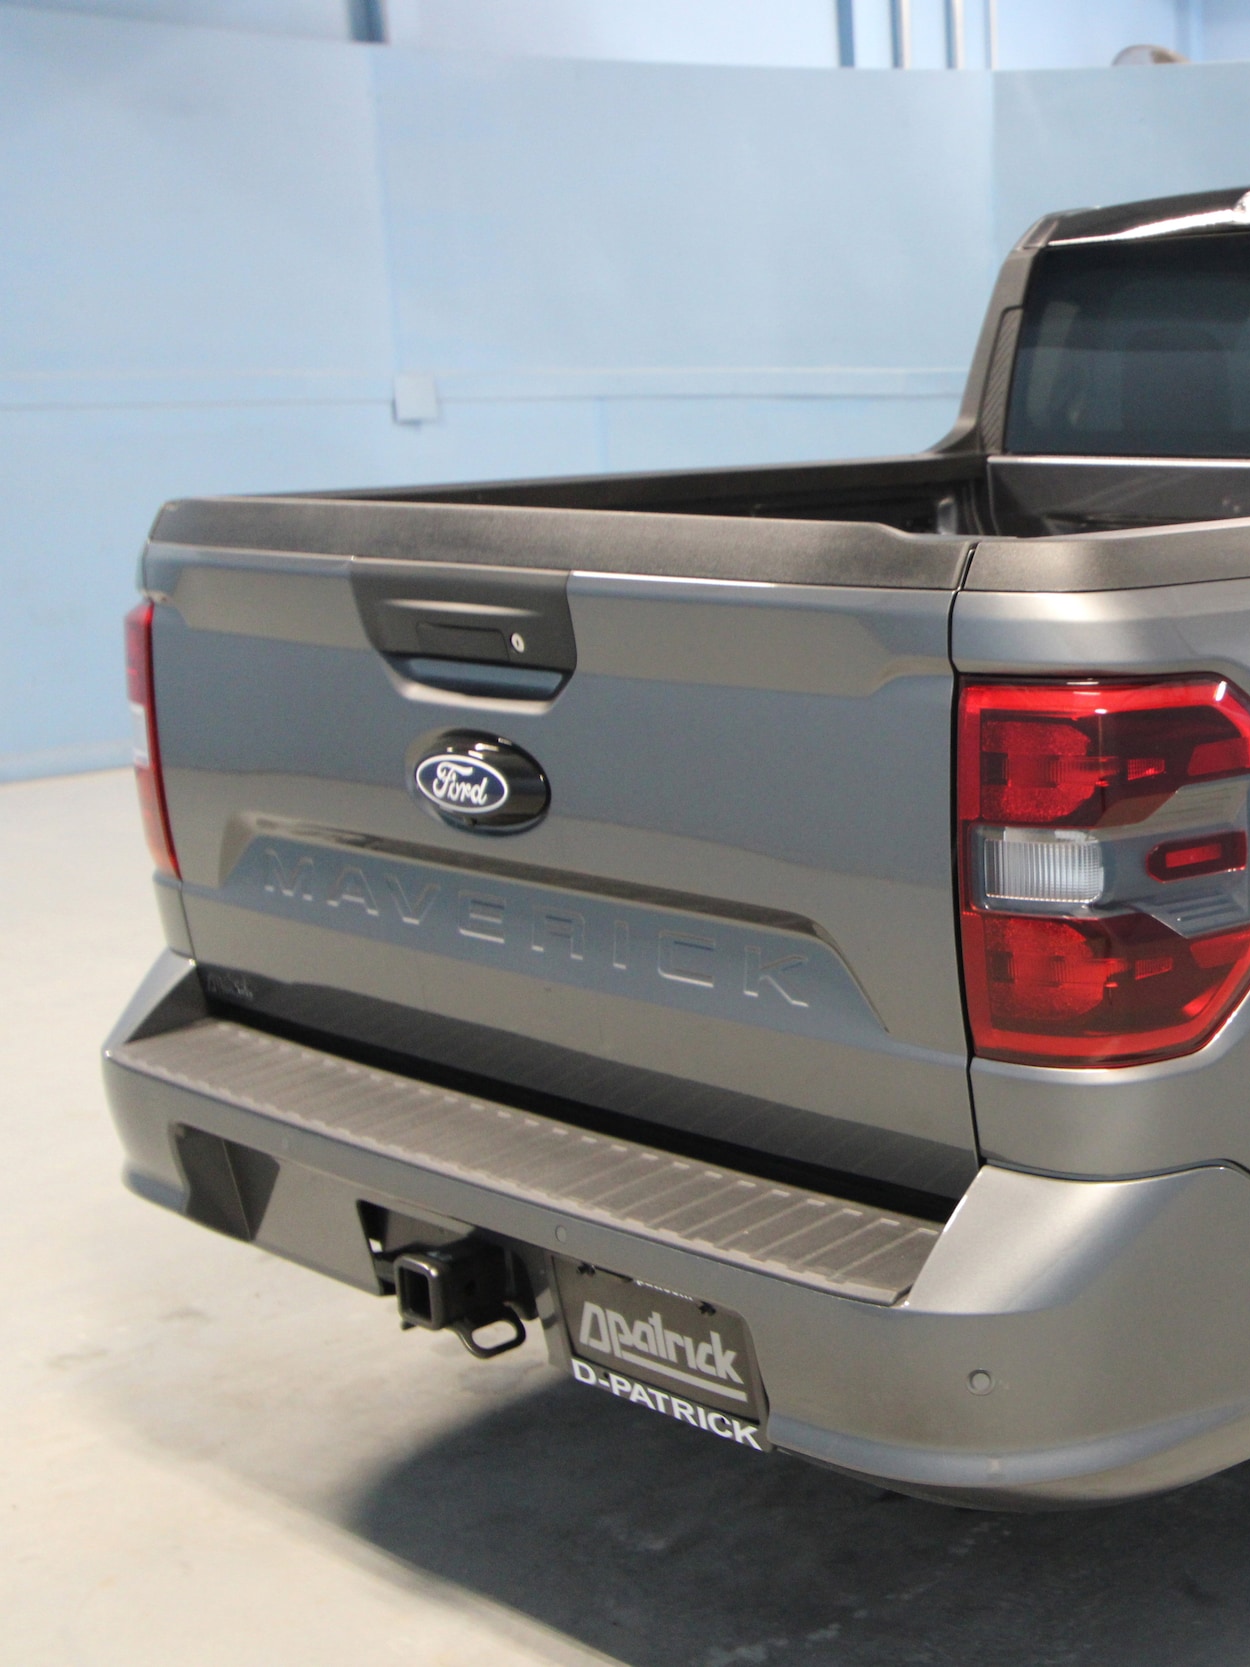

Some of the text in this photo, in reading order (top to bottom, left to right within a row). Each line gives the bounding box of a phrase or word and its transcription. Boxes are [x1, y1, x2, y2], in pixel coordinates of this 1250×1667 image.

[432, 761, 488, 805] Ford
[263, 849, 809, 1007] MAVERICK
[571, 1358, 763, 1451] D-PATRICK
